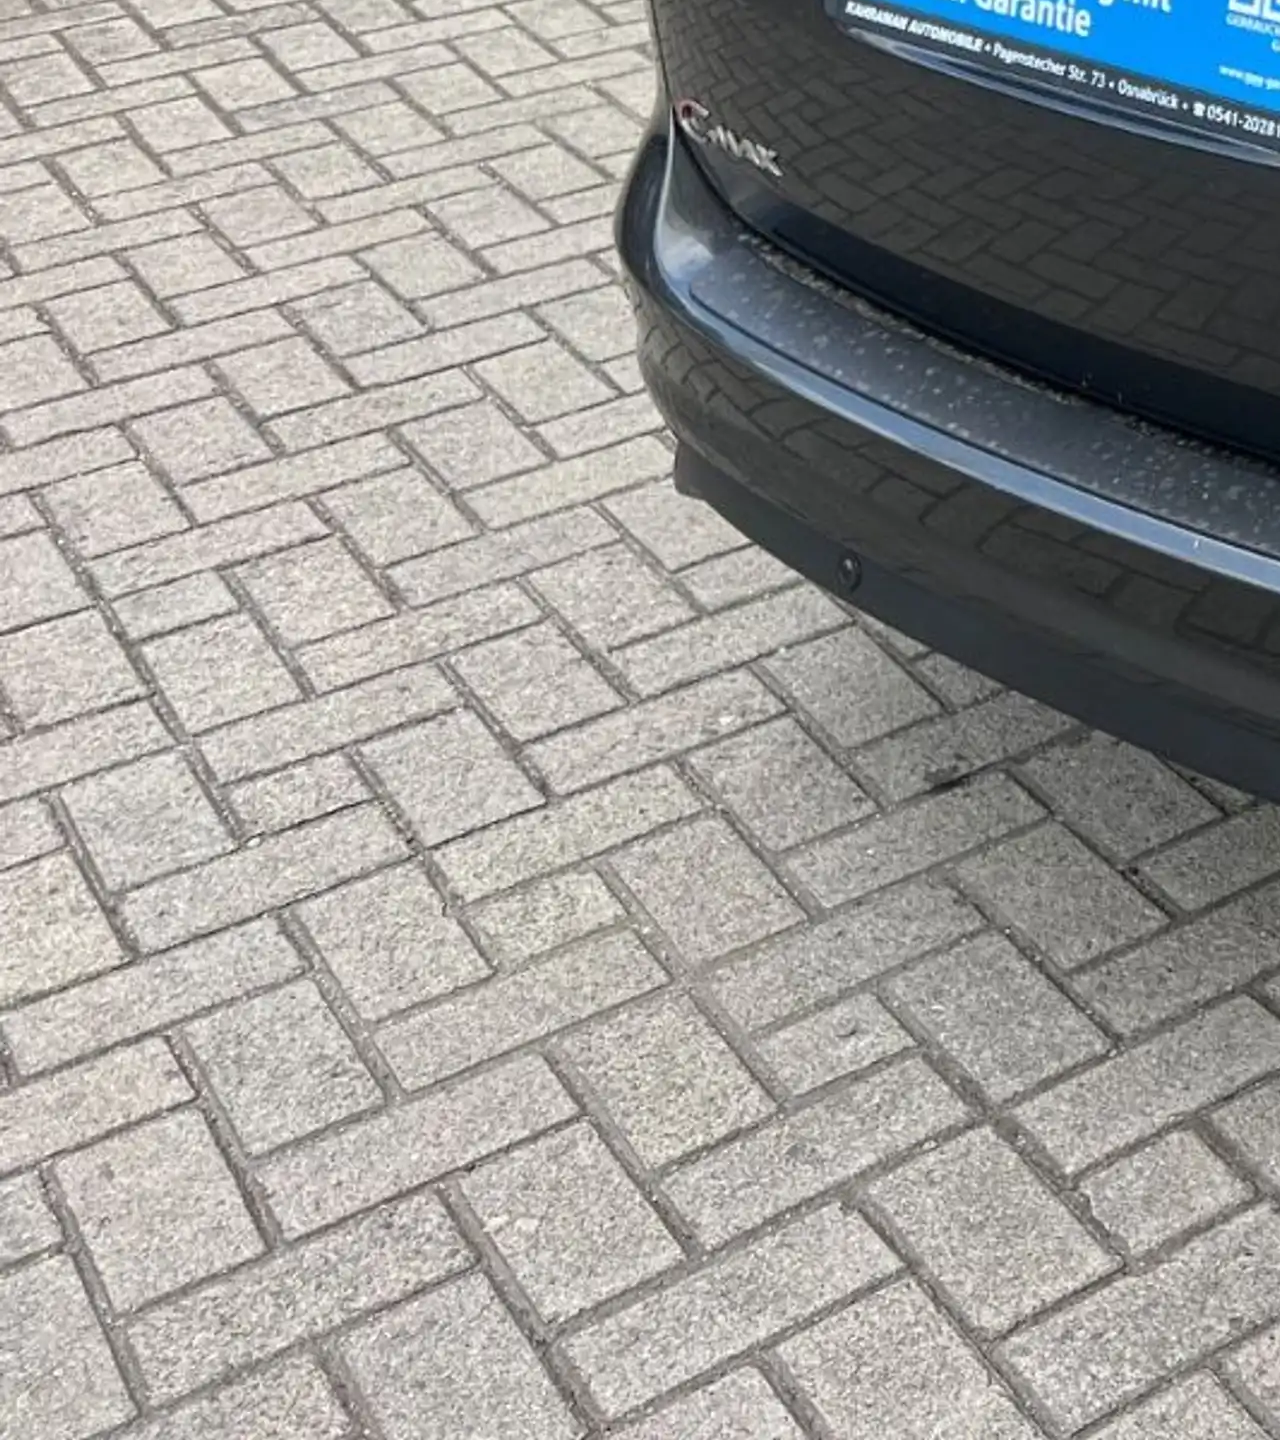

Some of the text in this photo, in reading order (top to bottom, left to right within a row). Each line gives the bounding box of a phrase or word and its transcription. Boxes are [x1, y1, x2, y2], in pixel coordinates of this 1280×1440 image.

[907, 19, 984, 52] AUTOMOBILE
[992, 41, 1067, 77] Pagenstecher
[1067, 63, 1088, 83] Str.
[1090, 69, 1106, 89] 73
[1117, 78, 1180, 111] Osnabrück
